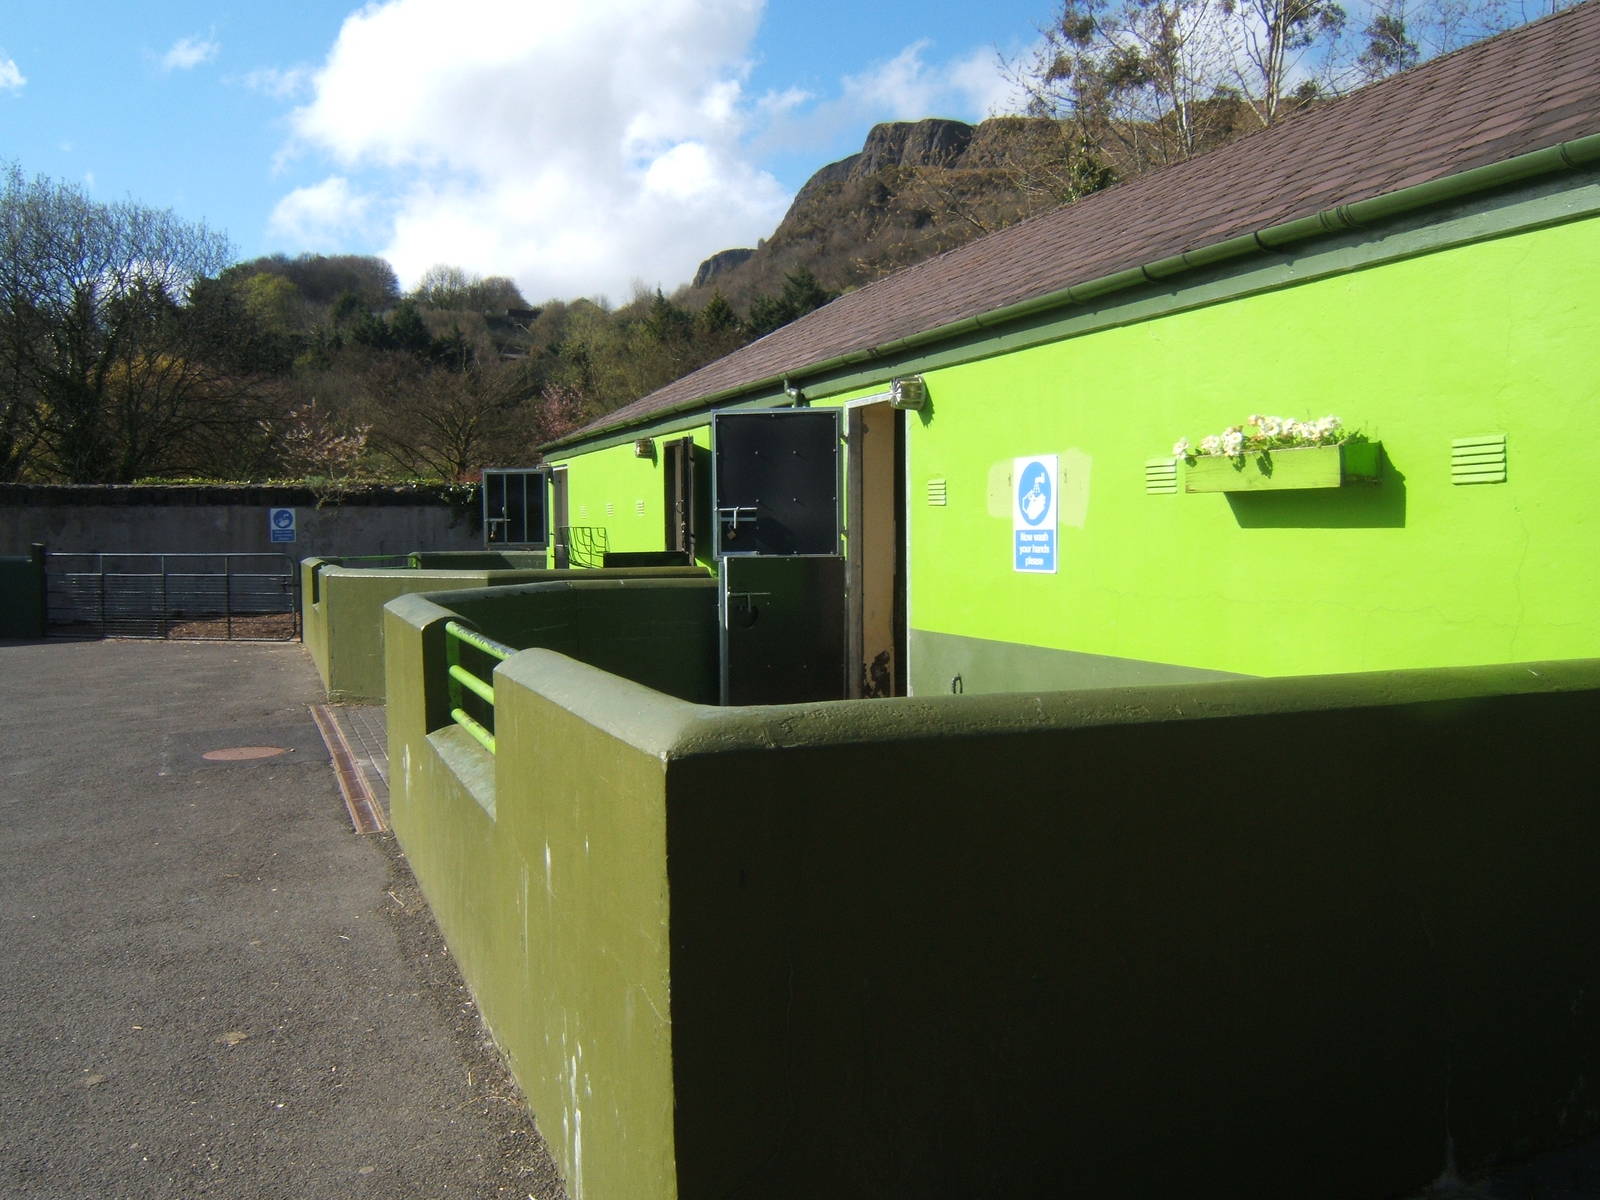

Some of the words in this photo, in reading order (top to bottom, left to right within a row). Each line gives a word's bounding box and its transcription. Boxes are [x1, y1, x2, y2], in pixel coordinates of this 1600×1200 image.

[1020, 532, 1032, 541] Now
[1019, 545, 1031, 555] your
[1032, 544, 1049, 553] hands
[1025, 556, 1044, 567] please
